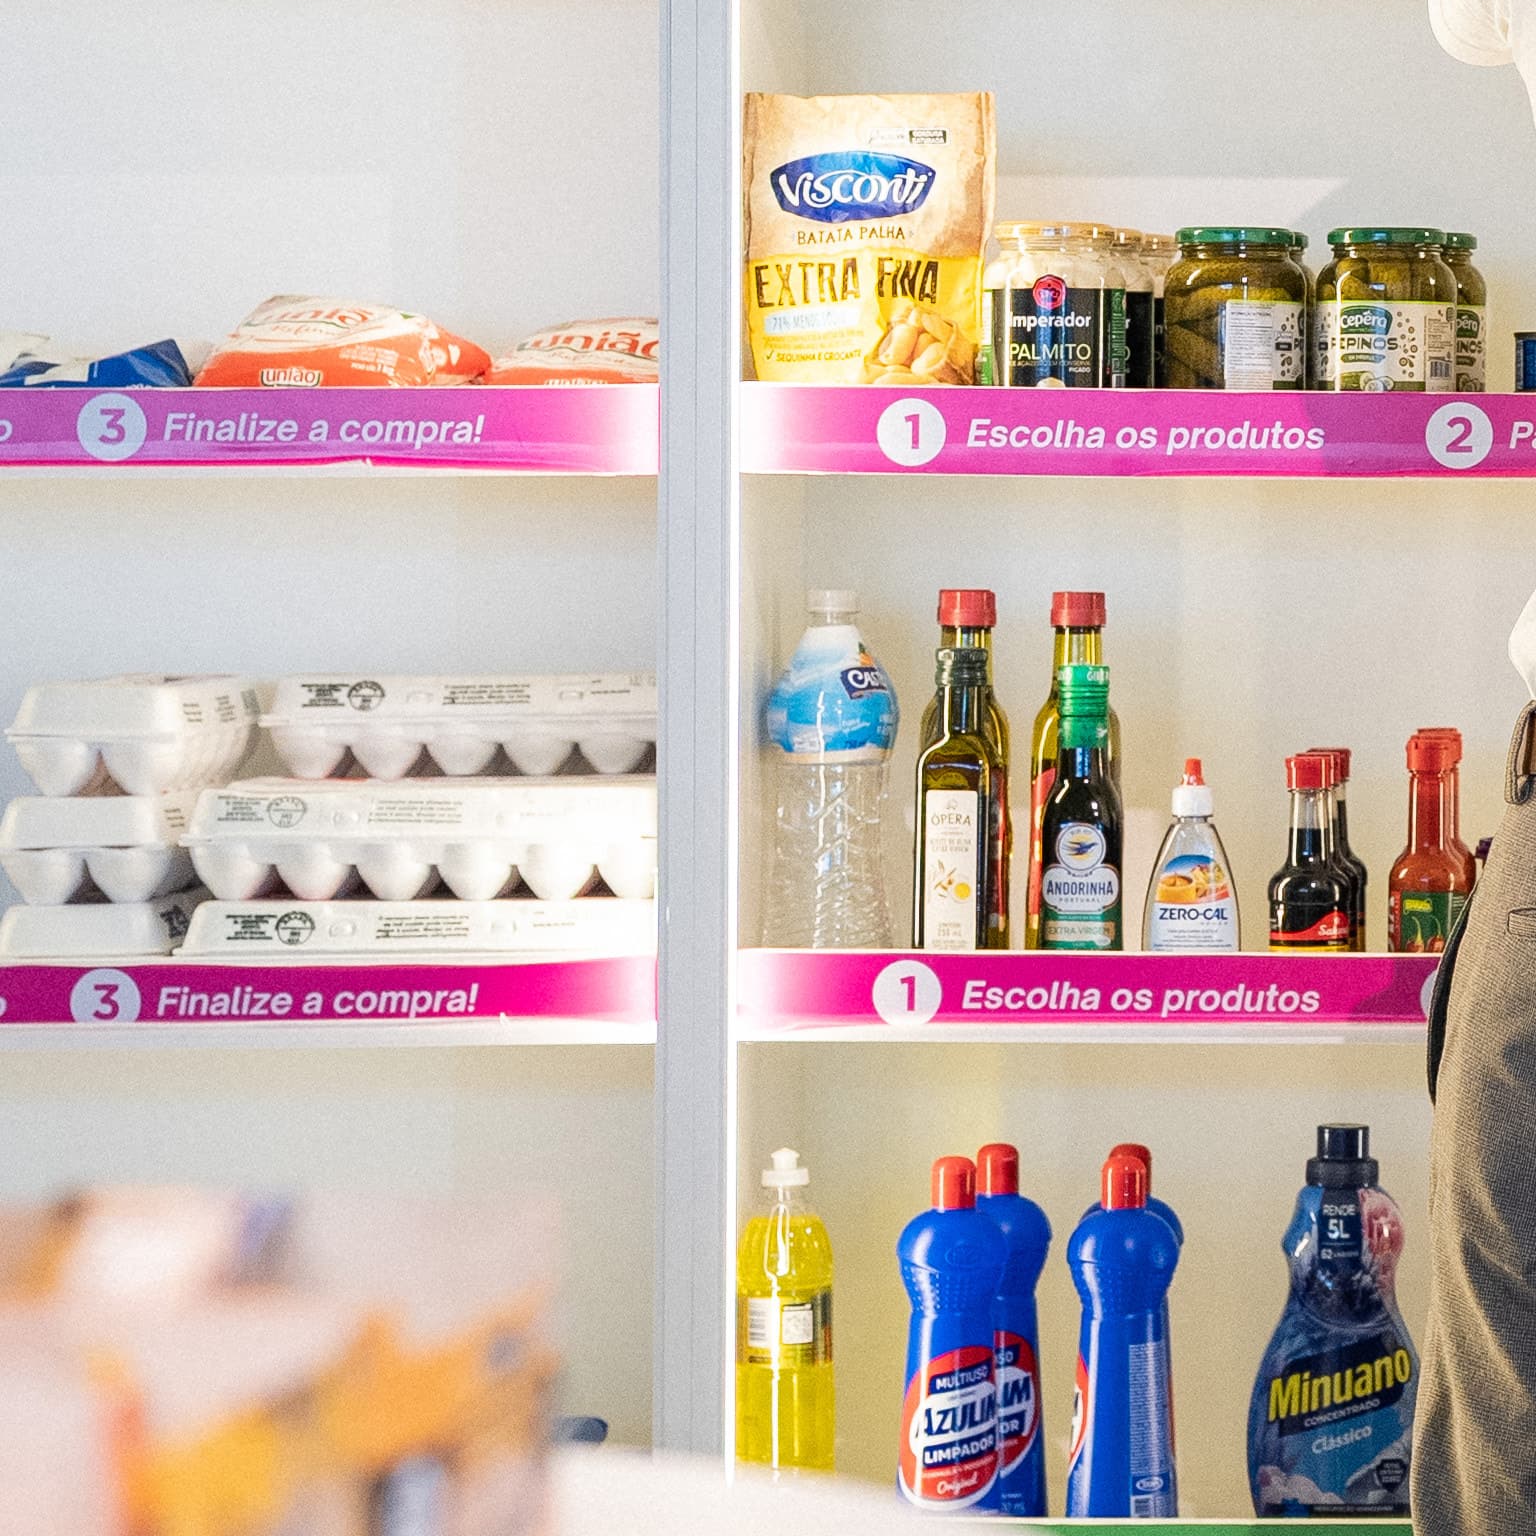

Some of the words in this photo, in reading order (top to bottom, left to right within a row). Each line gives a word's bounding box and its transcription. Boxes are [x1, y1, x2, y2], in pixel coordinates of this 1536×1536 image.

[778, 167, 928, 209] Visconti
[797, 228, 853, 245] BATATA
[858, 226, 906, 241] PALHA
[755, 257, 861, 308] EXTRA
[877, 256, 939, 304] FINA
[1341, 309, 1387, 332] Cepêra
[1008, 343, 1092, 361] PALMITO
[1331, 336, 1399, 353] PEPINOS
[98, 408, 126, 445] 3
[163, 412, 297, 443] Finalize
[309, 420, 329, 443] a
[339, 414, 486, 450] compra!
[903, 413, 920, 450] 1
[966, 418, 1104, 449] Escolha
[1115, 426, 1157, 450] os
[1166, 420, 1326, 457] produtos
[1445, 417, 1474, 454] 2
[1046, 880, 1114, 895] ANDORINHA
[1159, 907, 1229, 921] ZERO-CAL
[92, 983, 121, 1020] 3
[157, 983, 293, 1017] Finalize
[303, 993, 324, 1015] a
[334, 983, 480, 1020] compra!
[899, 975, 918, 1012] 1
[961, 979, 1101, 1012] Escolha
[1110, 989, 1152, 1012] os
[1160, 981, 1321, 1018] produtos
[1322, 1204, 1356, 1217] RENDE
[1327, 1219, 1351, 1240] 5L
[935, 1366, 990, 1391] MULTIUSO
[1267, 1348, 1412, 1423] Minuano
[1303, 1397, 1381, 1428] CONCENTRADO
[923, 1433, 995, 1465] LIMPADOR
[1311, 1423, 1373, 1455] Clássico
[936, 1472, 979, 1496] Original
